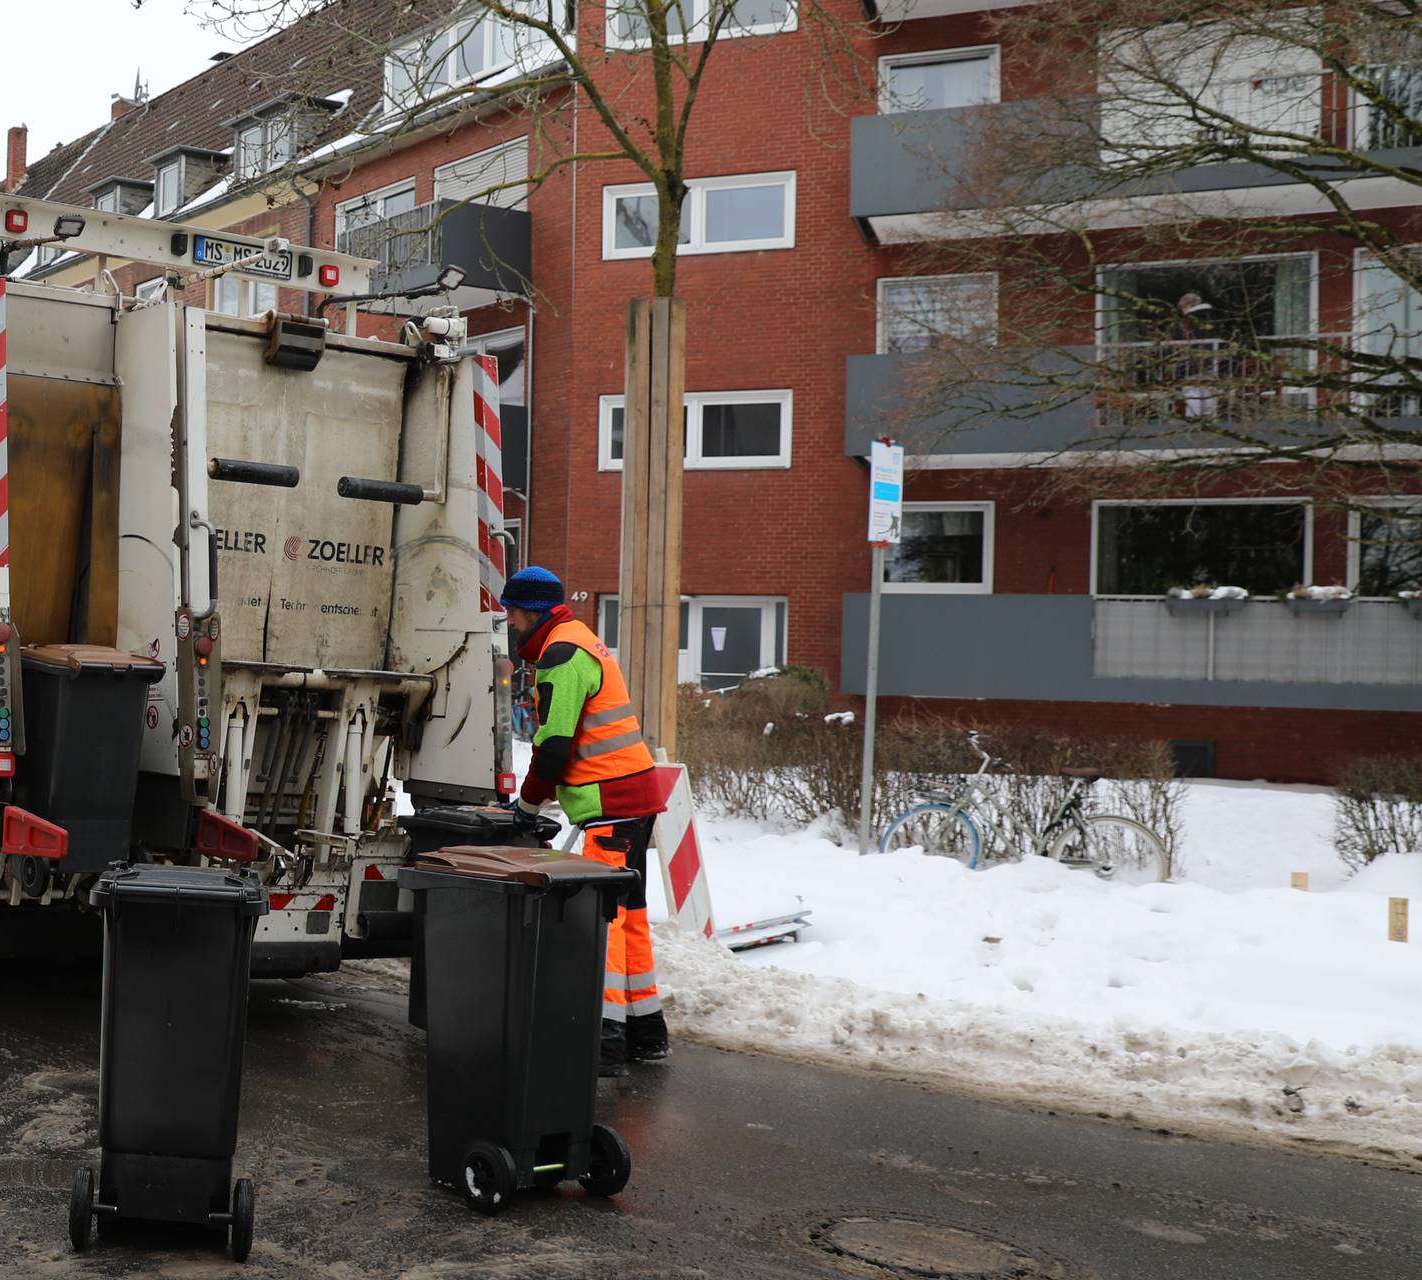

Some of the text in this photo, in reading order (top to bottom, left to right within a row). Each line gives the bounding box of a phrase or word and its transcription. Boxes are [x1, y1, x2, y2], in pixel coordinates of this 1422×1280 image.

[205, 240, 223, 260] MS
[215, 528, 267, 554] ELLER
[307, 539, 385, 567] ZOELLER
[571, 591, 588, 602] 49
